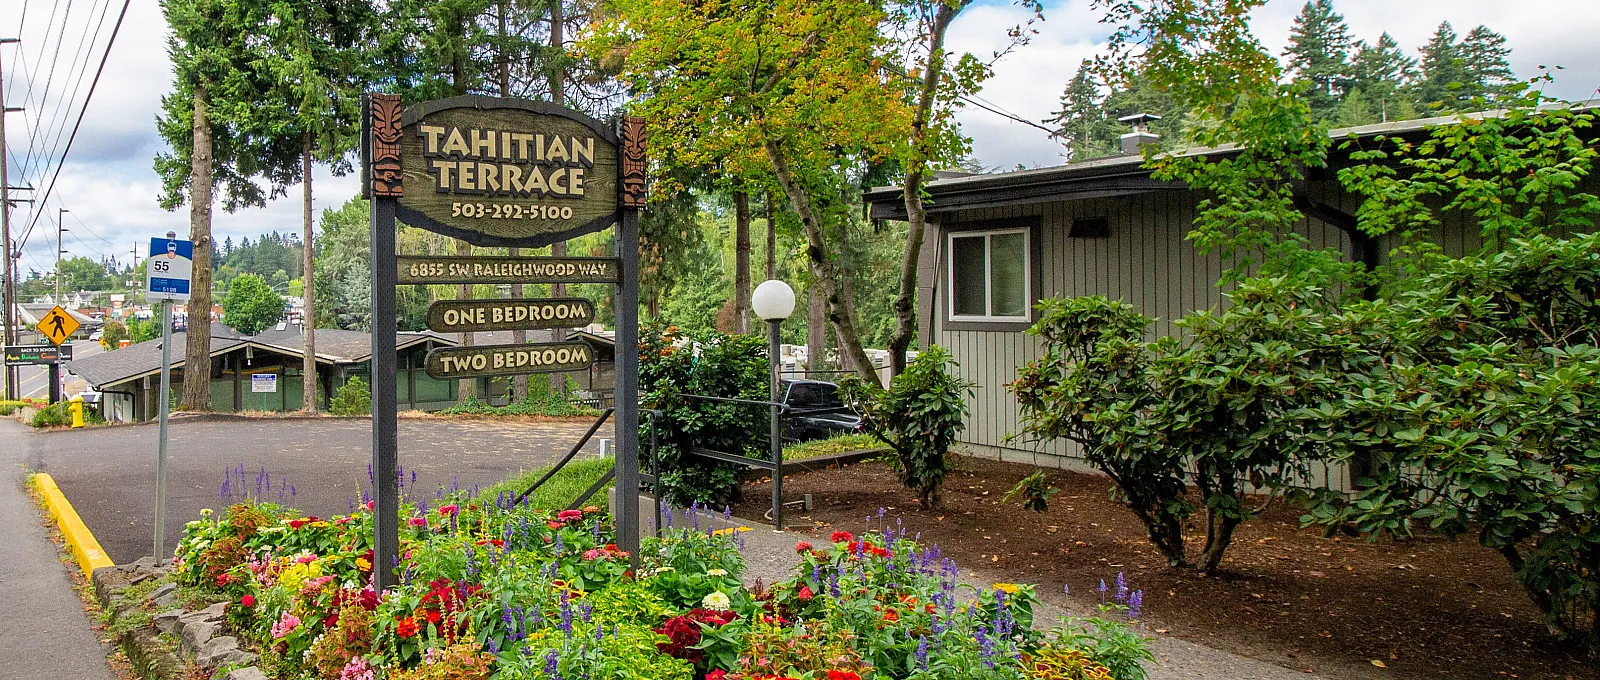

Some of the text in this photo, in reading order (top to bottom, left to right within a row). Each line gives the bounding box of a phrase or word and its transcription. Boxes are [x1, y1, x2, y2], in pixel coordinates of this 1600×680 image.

[420, 125, 595, 164] TAHITIAN
[432, 160, 584, 196] TERRACE
[451, 202, 573, 220] 503-292-5100
[154, 261, 170, 270] 55
[410, 263, 607, 277] 6855 SW RALEIGHWOOD WAY
[443, 304, 586, 326] ONE BEDROOM
[440, 347, 587, 373] TWO BEDROOM
